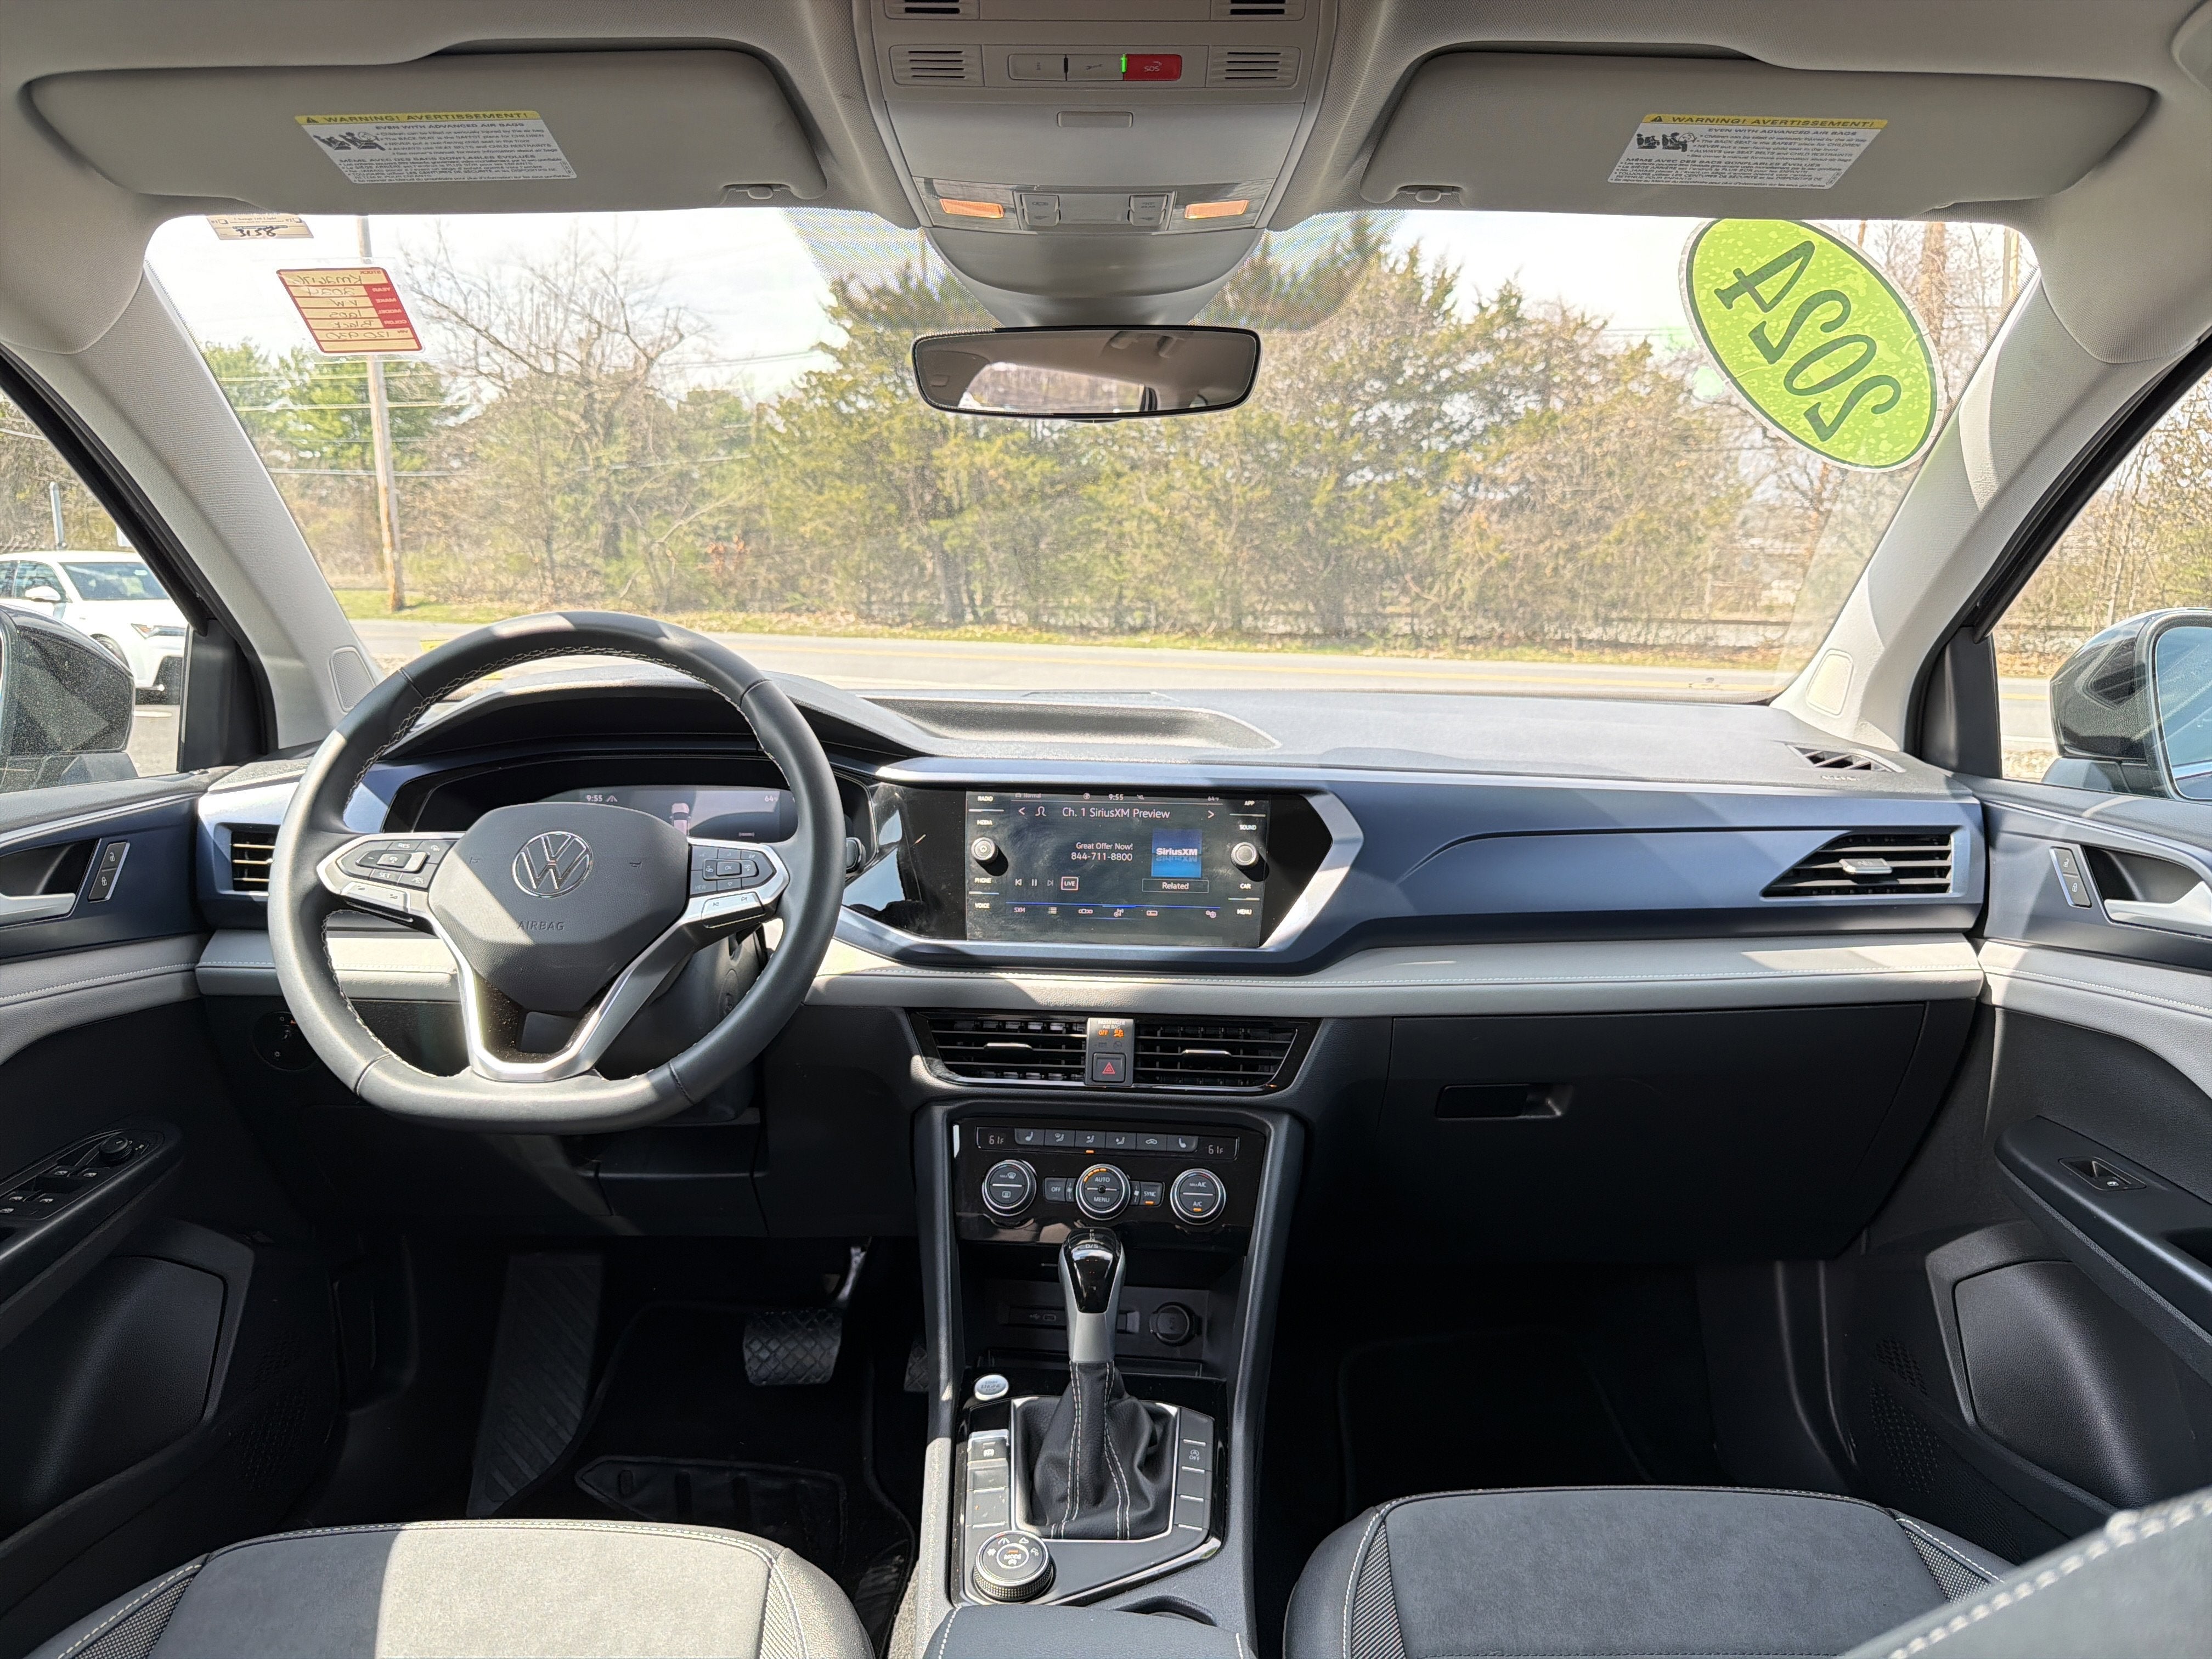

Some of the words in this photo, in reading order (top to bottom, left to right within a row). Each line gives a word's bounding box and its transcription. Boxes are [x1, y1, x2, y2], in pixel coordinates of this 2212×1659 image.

[1751, 119, 1875, 127] AVERTISSEMENT!
[1062, 807, 1077, 817] Ch.
[1081, 808, 1087, 816] 1
[1090, 808, 1130, 817] SiriusXM
[1133, 809, 1170, 818] Preview
[1071, 852, 1133, 861] 844-711-8800
[1162, 882, 1189, 890] Related
[517, 921, 565, 931] AIRBAG
